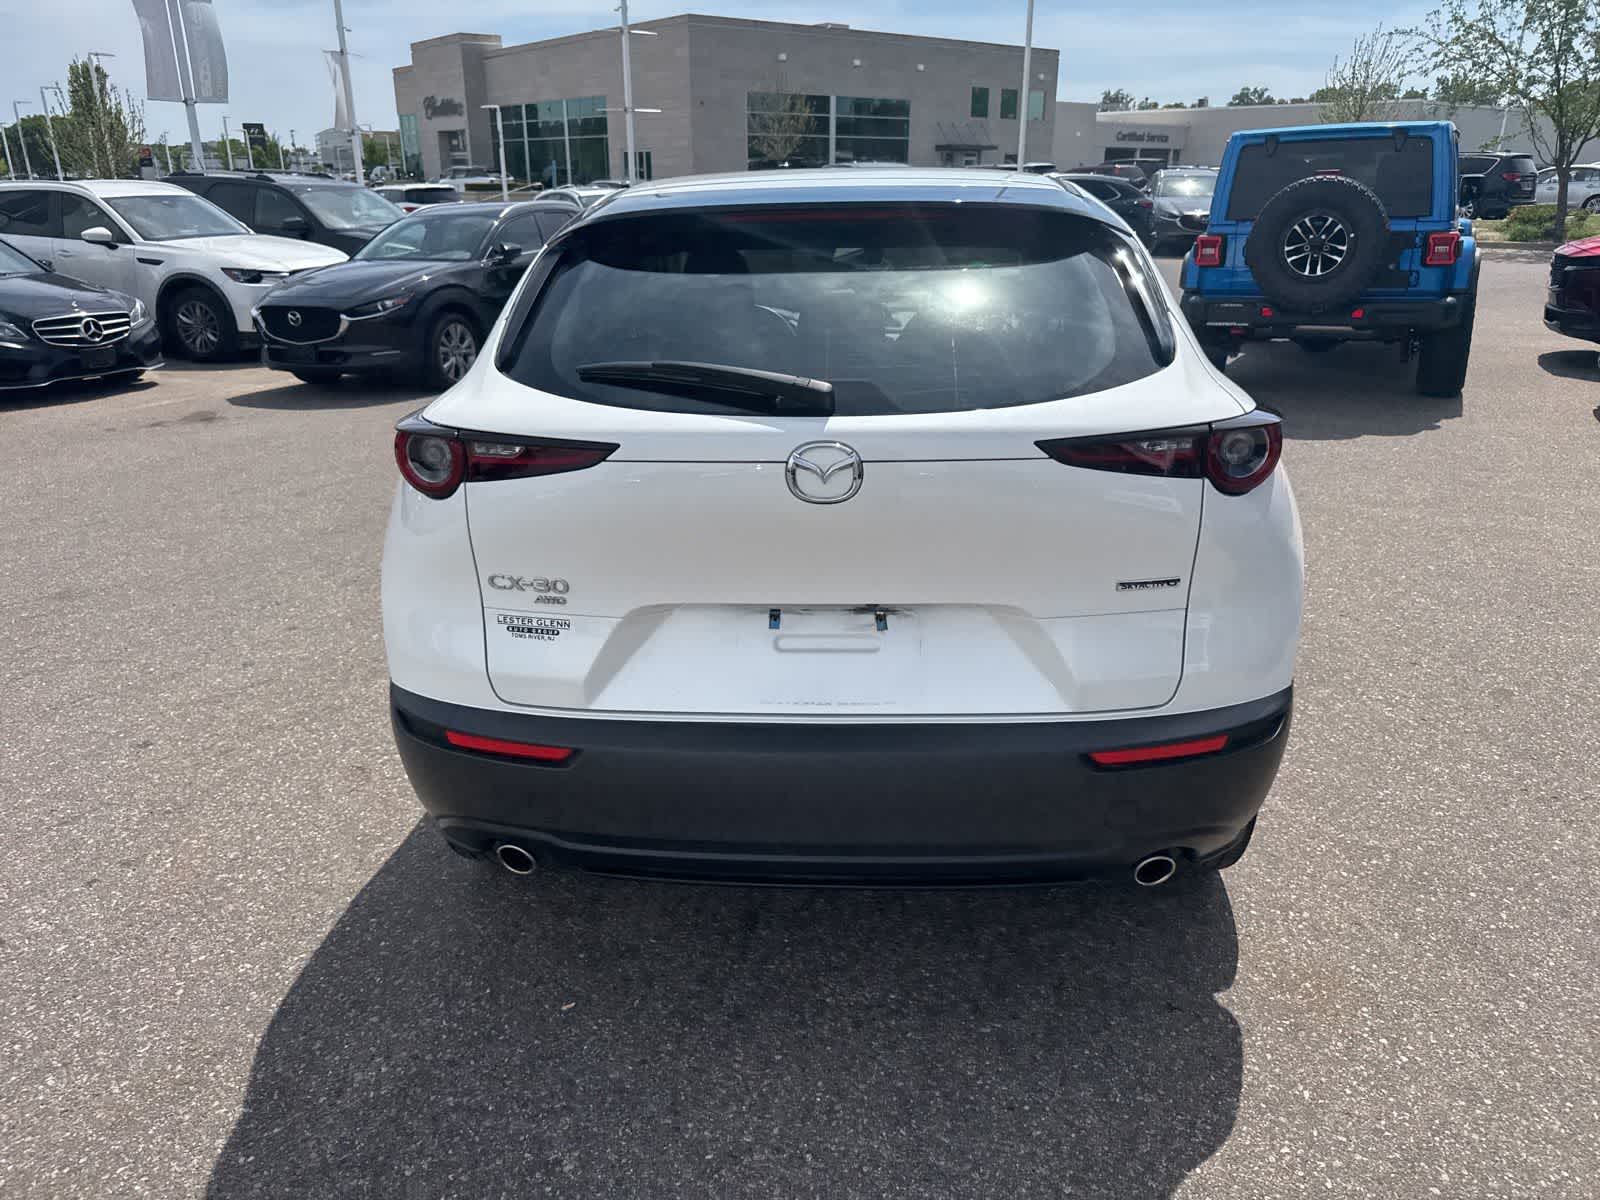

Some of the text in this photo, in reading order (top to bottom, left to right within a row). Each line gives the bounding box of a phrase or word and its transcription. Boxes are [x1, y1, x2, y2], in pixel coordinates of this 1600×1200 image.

[488, 574, 570, 594] CX-30
[534, 595, 568, 605] AWD
[497, 615, 571, 629] LESTER GLENN
[531, 628, 559, 636] GROUP
